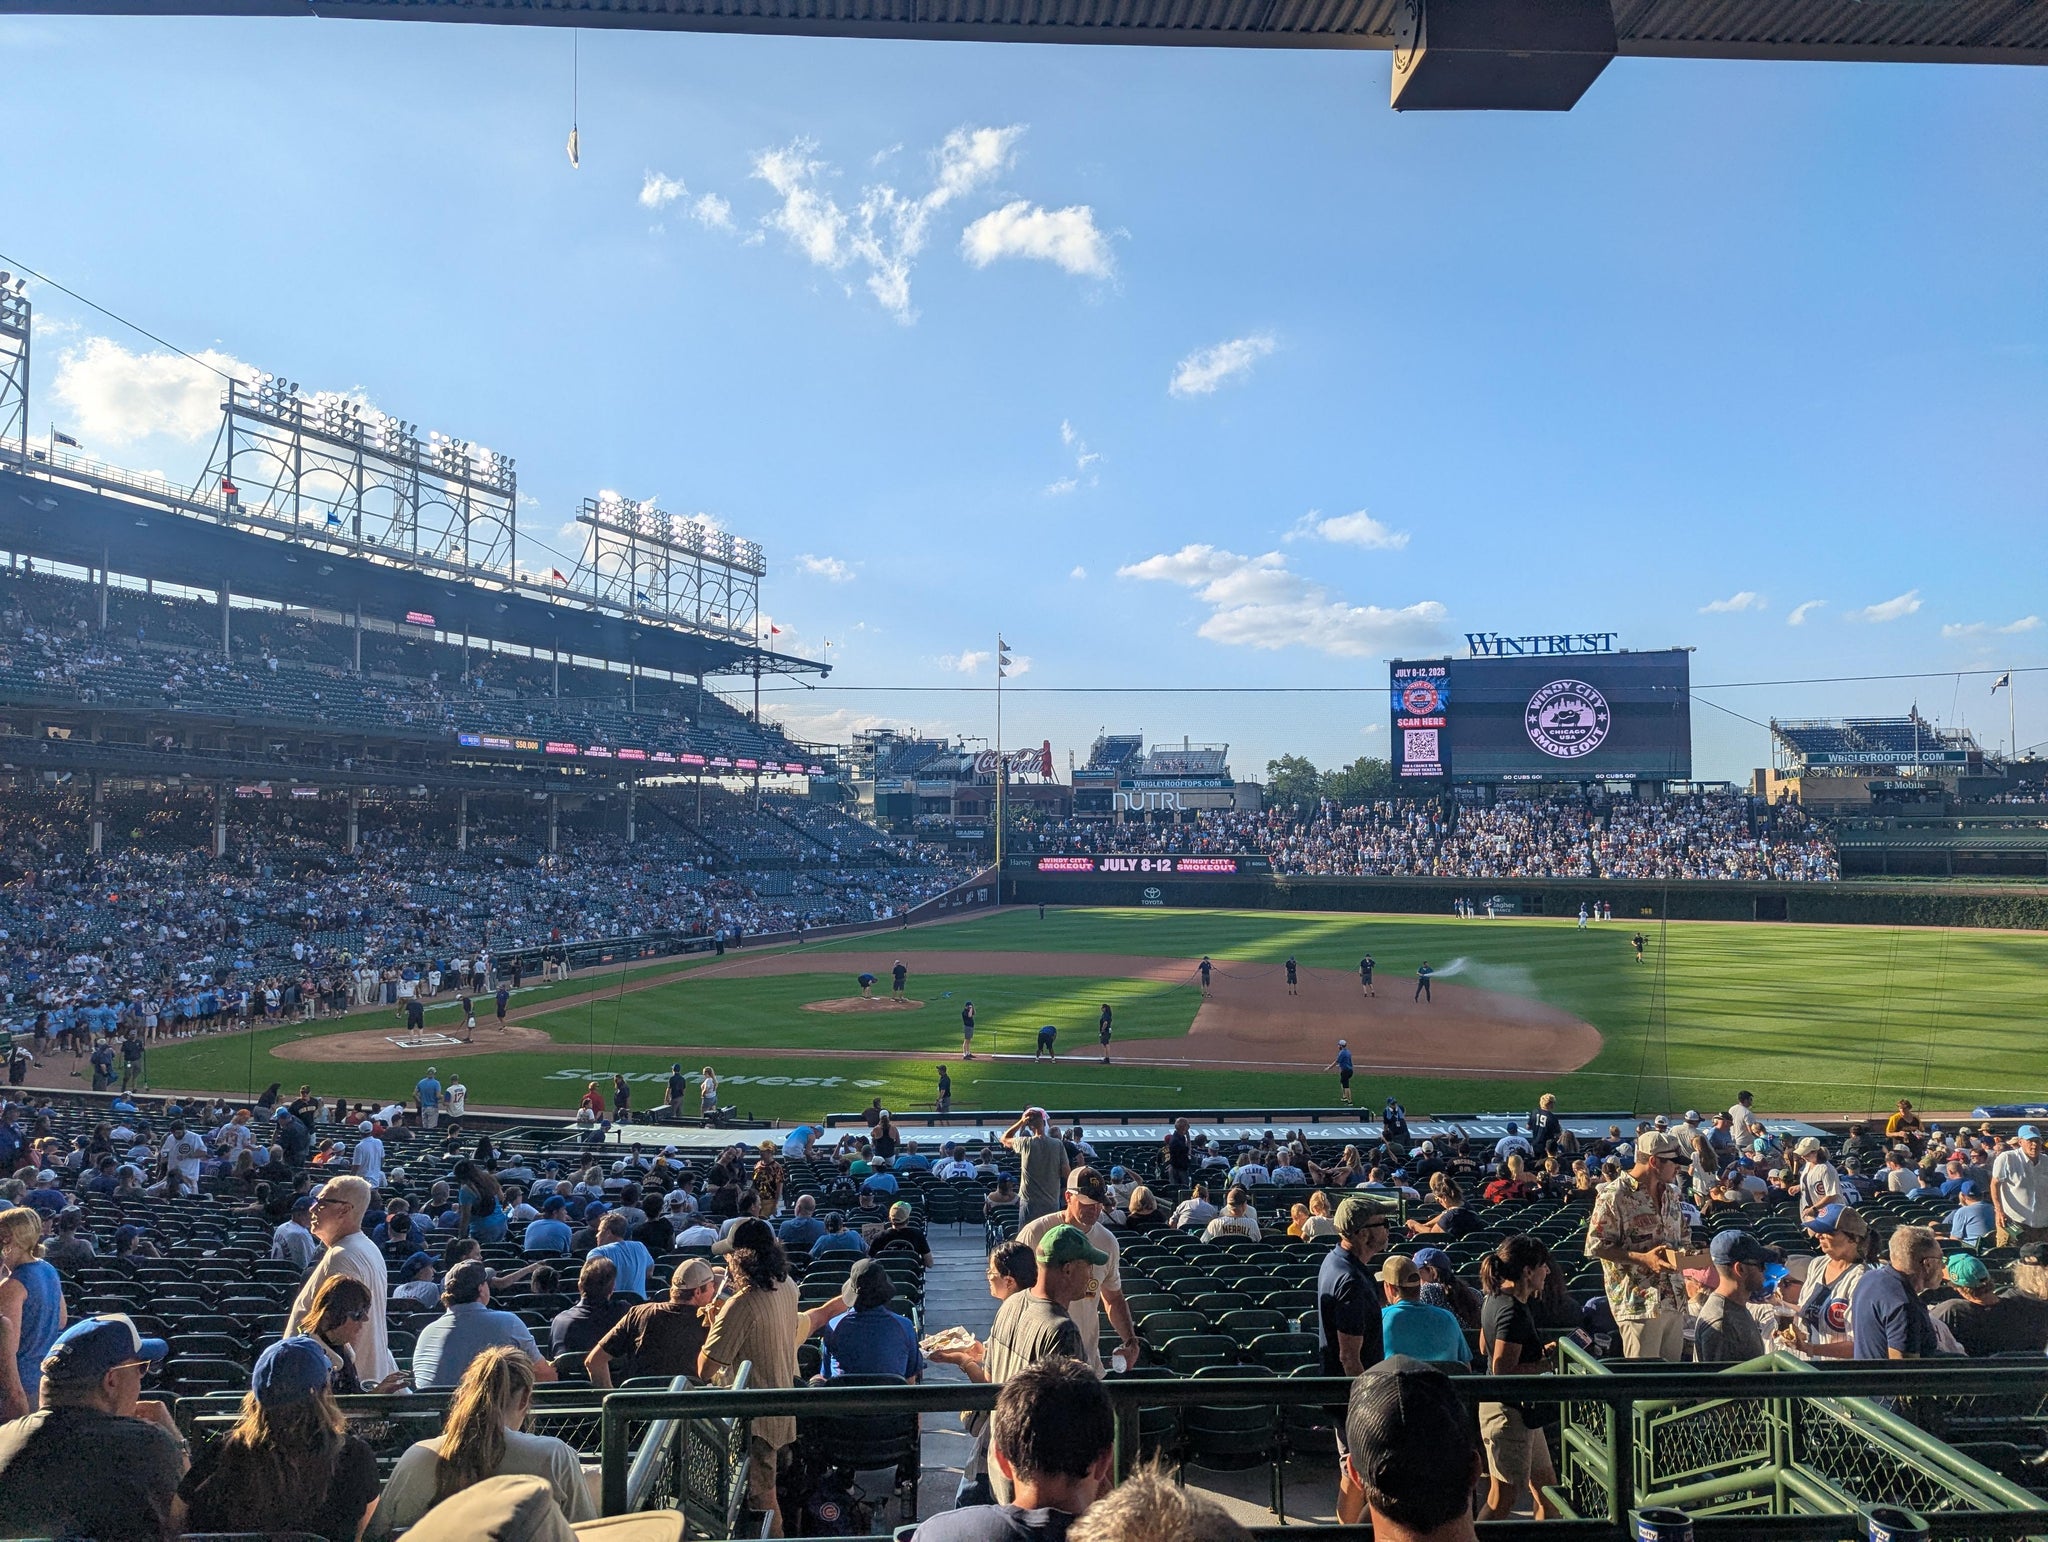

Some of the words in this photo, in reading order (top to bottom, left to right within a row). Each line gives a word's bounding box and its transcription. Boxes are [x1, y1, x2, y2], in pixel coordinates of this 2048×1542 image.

[1464, 632, 1618, 656] WINTRUST
[1395, 668, 1411, 678] JULY
[1429, 668, 1445, 676] 2026
[1530, 682, 1572, 709] WINDY
[1576, 684, 1604, 708] CITY
[1397, 718, 1420, 727] SCAN
[1422, 717, 1445, 726] HERE
[515, 740, 538, 750] $50,000
[1530, 726, 1604, 756] SMOKEOUT
[1894, 781, 1926, 789] Mobile
[1010, 858, 1032, 867] Harvey
[1100, 859, 1137, 872] JULY
[1141, 859, 1171, 872] 8-12
[977, 888, 988, 902] YETI
[1483, 901, 1515, 909] Glagher
[543, 1069, 848, 1088] Southwest
[453, 1092, 464, 1103] 17
[1535, 1113, 1547, 1128] 19
[1061, 1128, 1156, 1138] ENDLY
[1168, 1127, 1291, 1137] ONFINS
[1337, 1126, 1447, 1136] WRILEY
[1842, 1191, 1859, 1204] 17
[1222, 1224, 1251, 1236] MERRILL
